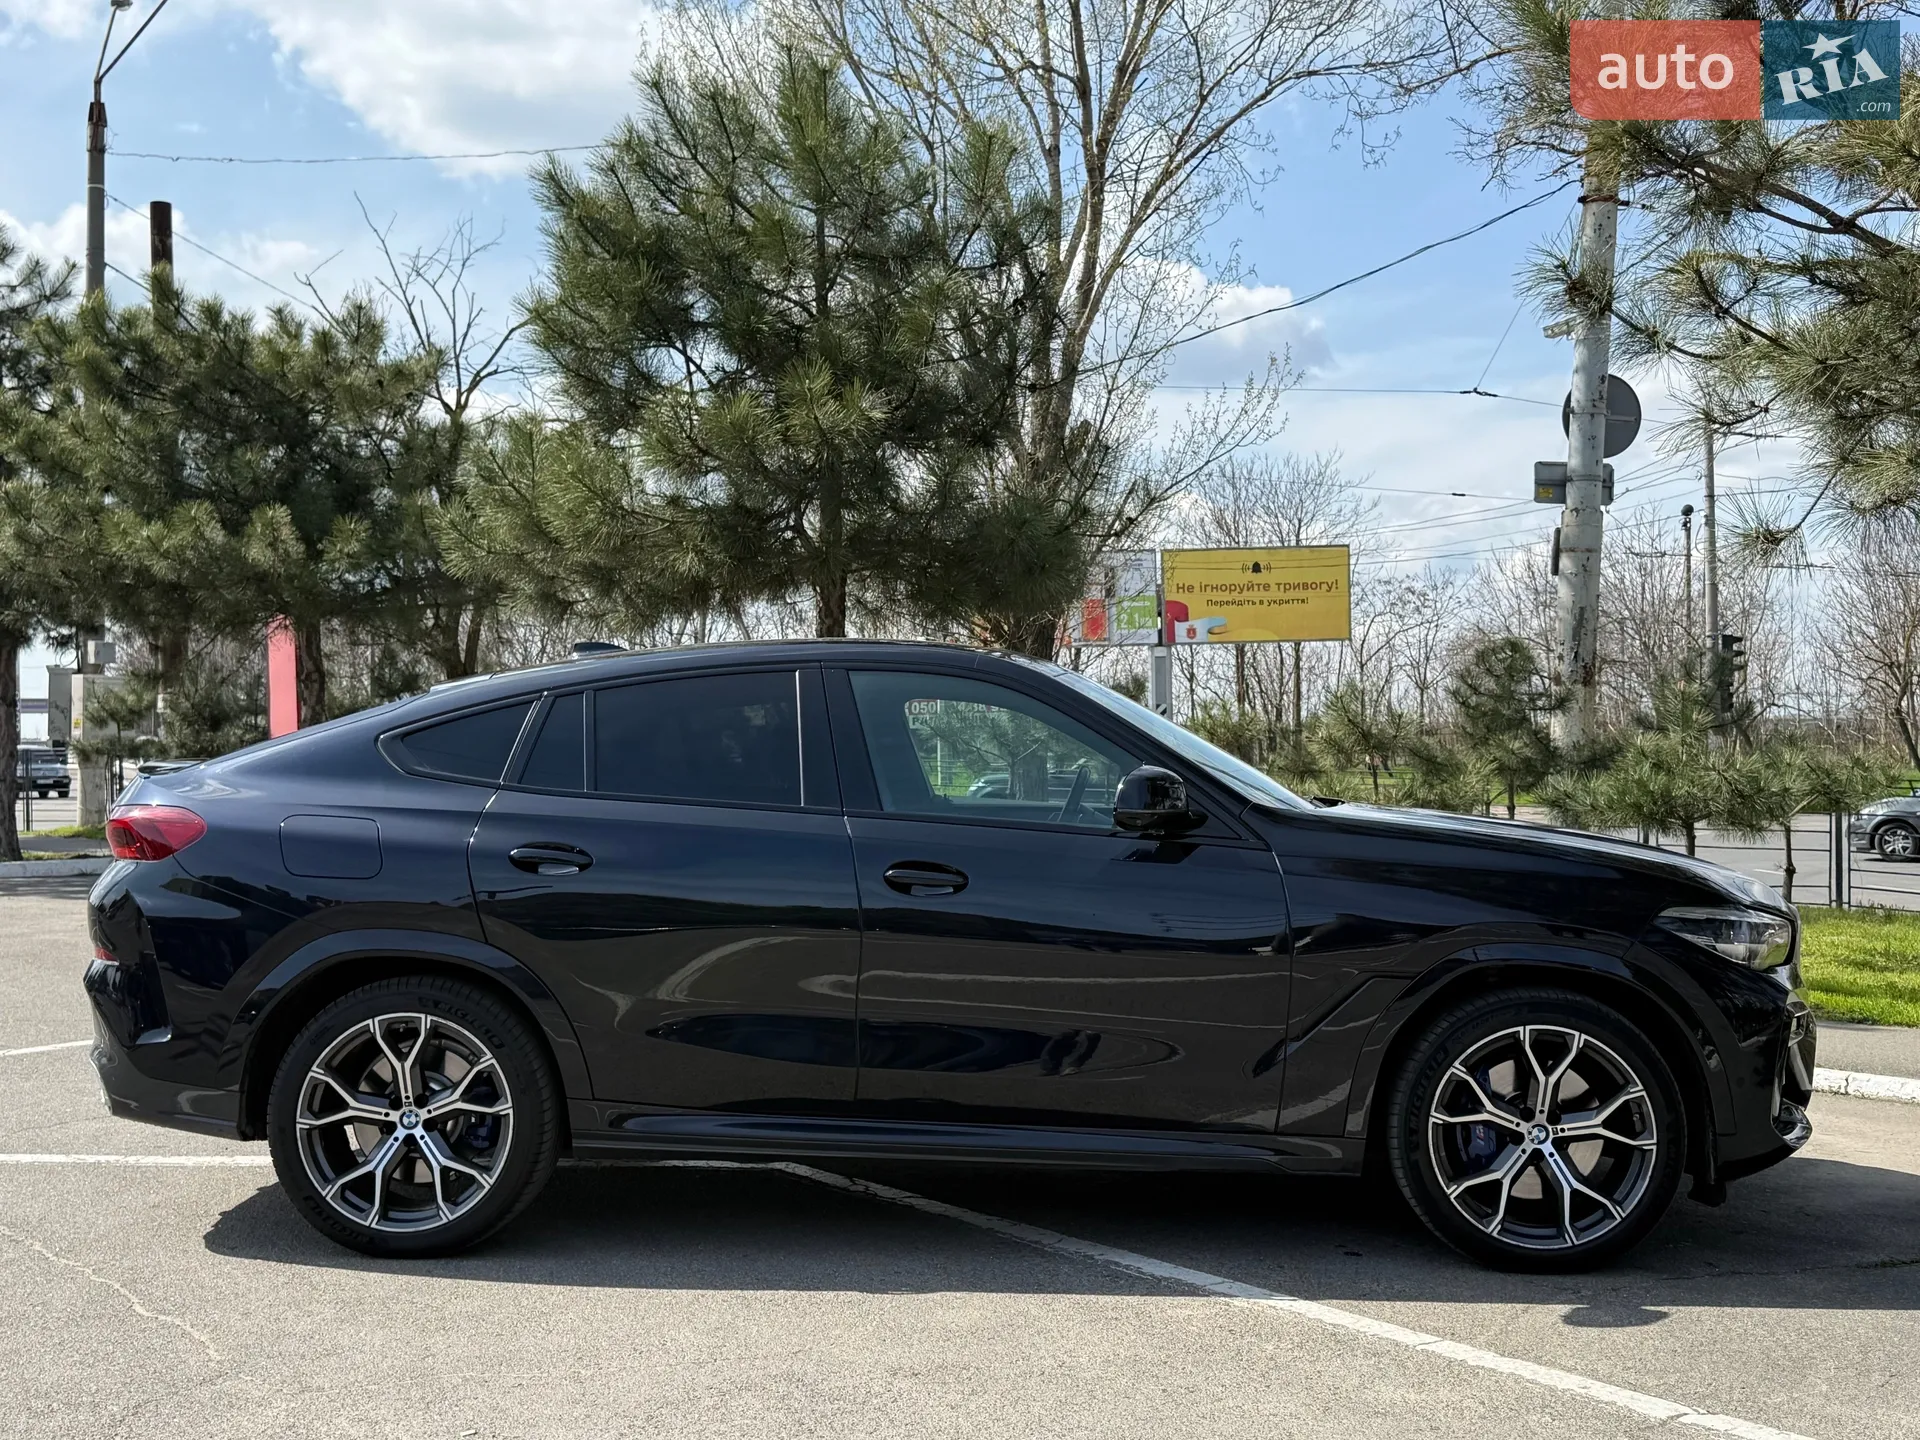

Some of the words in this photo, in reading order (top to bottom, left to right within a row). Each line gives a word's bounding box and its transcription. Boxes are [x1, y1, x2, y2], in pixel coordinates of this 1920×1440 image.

[1176, 582, 1195, 594] Не
[1199, 580, 1271, 595] ігноруйте
[1275, 579, 1339, 594] тривогу!
[1206, 598, 1257, 608] Перейдіть
[1266, 597, 1309, 607] укриття!
[911, 701, 937, 714] 050
